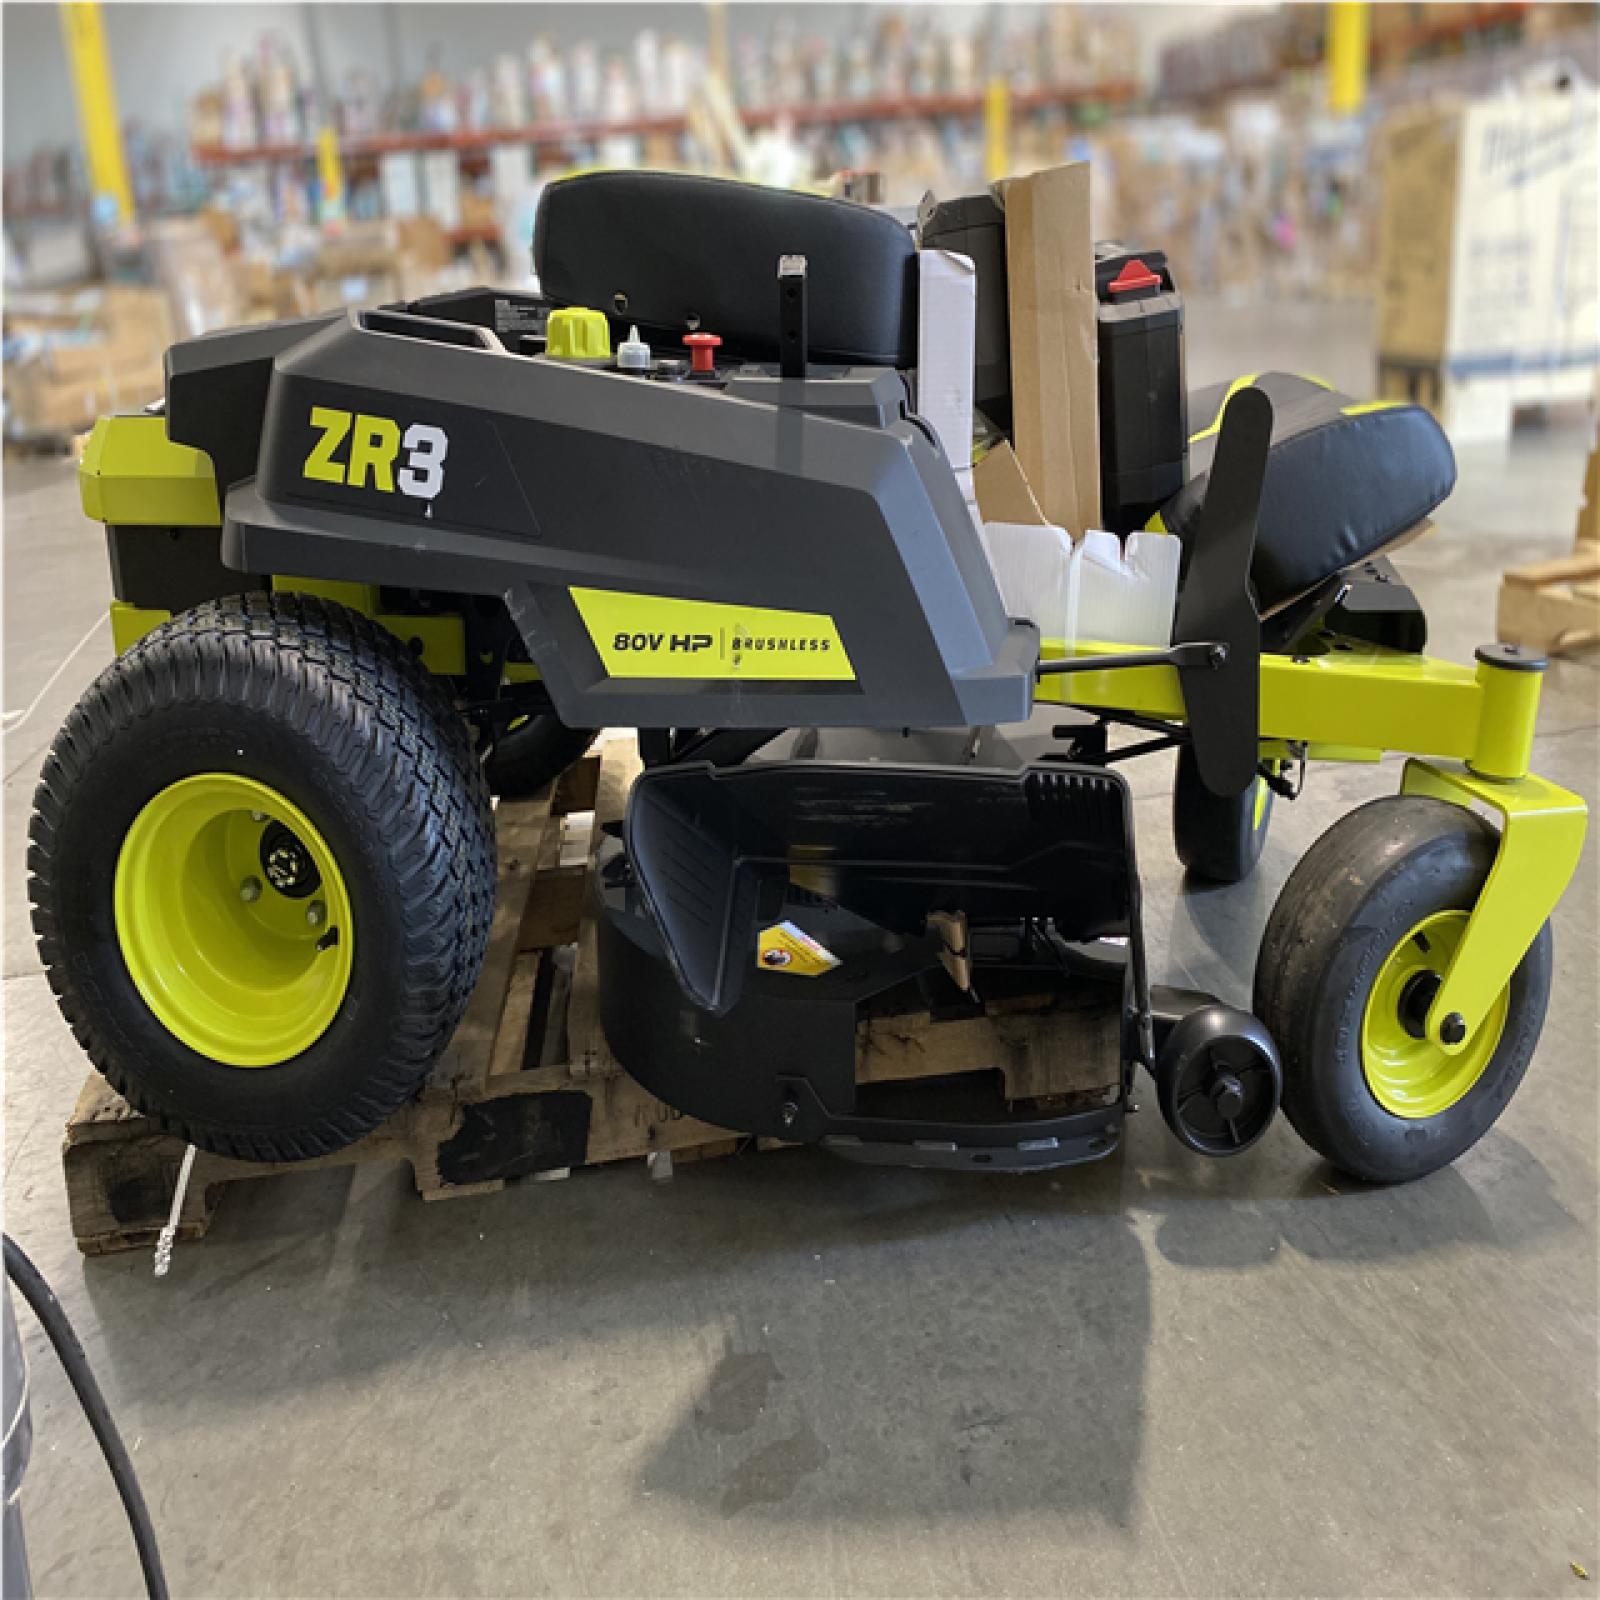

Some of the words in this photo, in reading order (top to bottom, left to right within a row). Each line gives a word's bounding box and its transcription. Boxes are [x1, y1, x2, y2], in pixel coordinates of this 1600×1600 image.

[303, 406, 449, 500] ZR3
[613, 633, 664, 651] 80V
[669, 633, 713, 653] HP
[732, 637, 831, 651] BRUSHLESS
